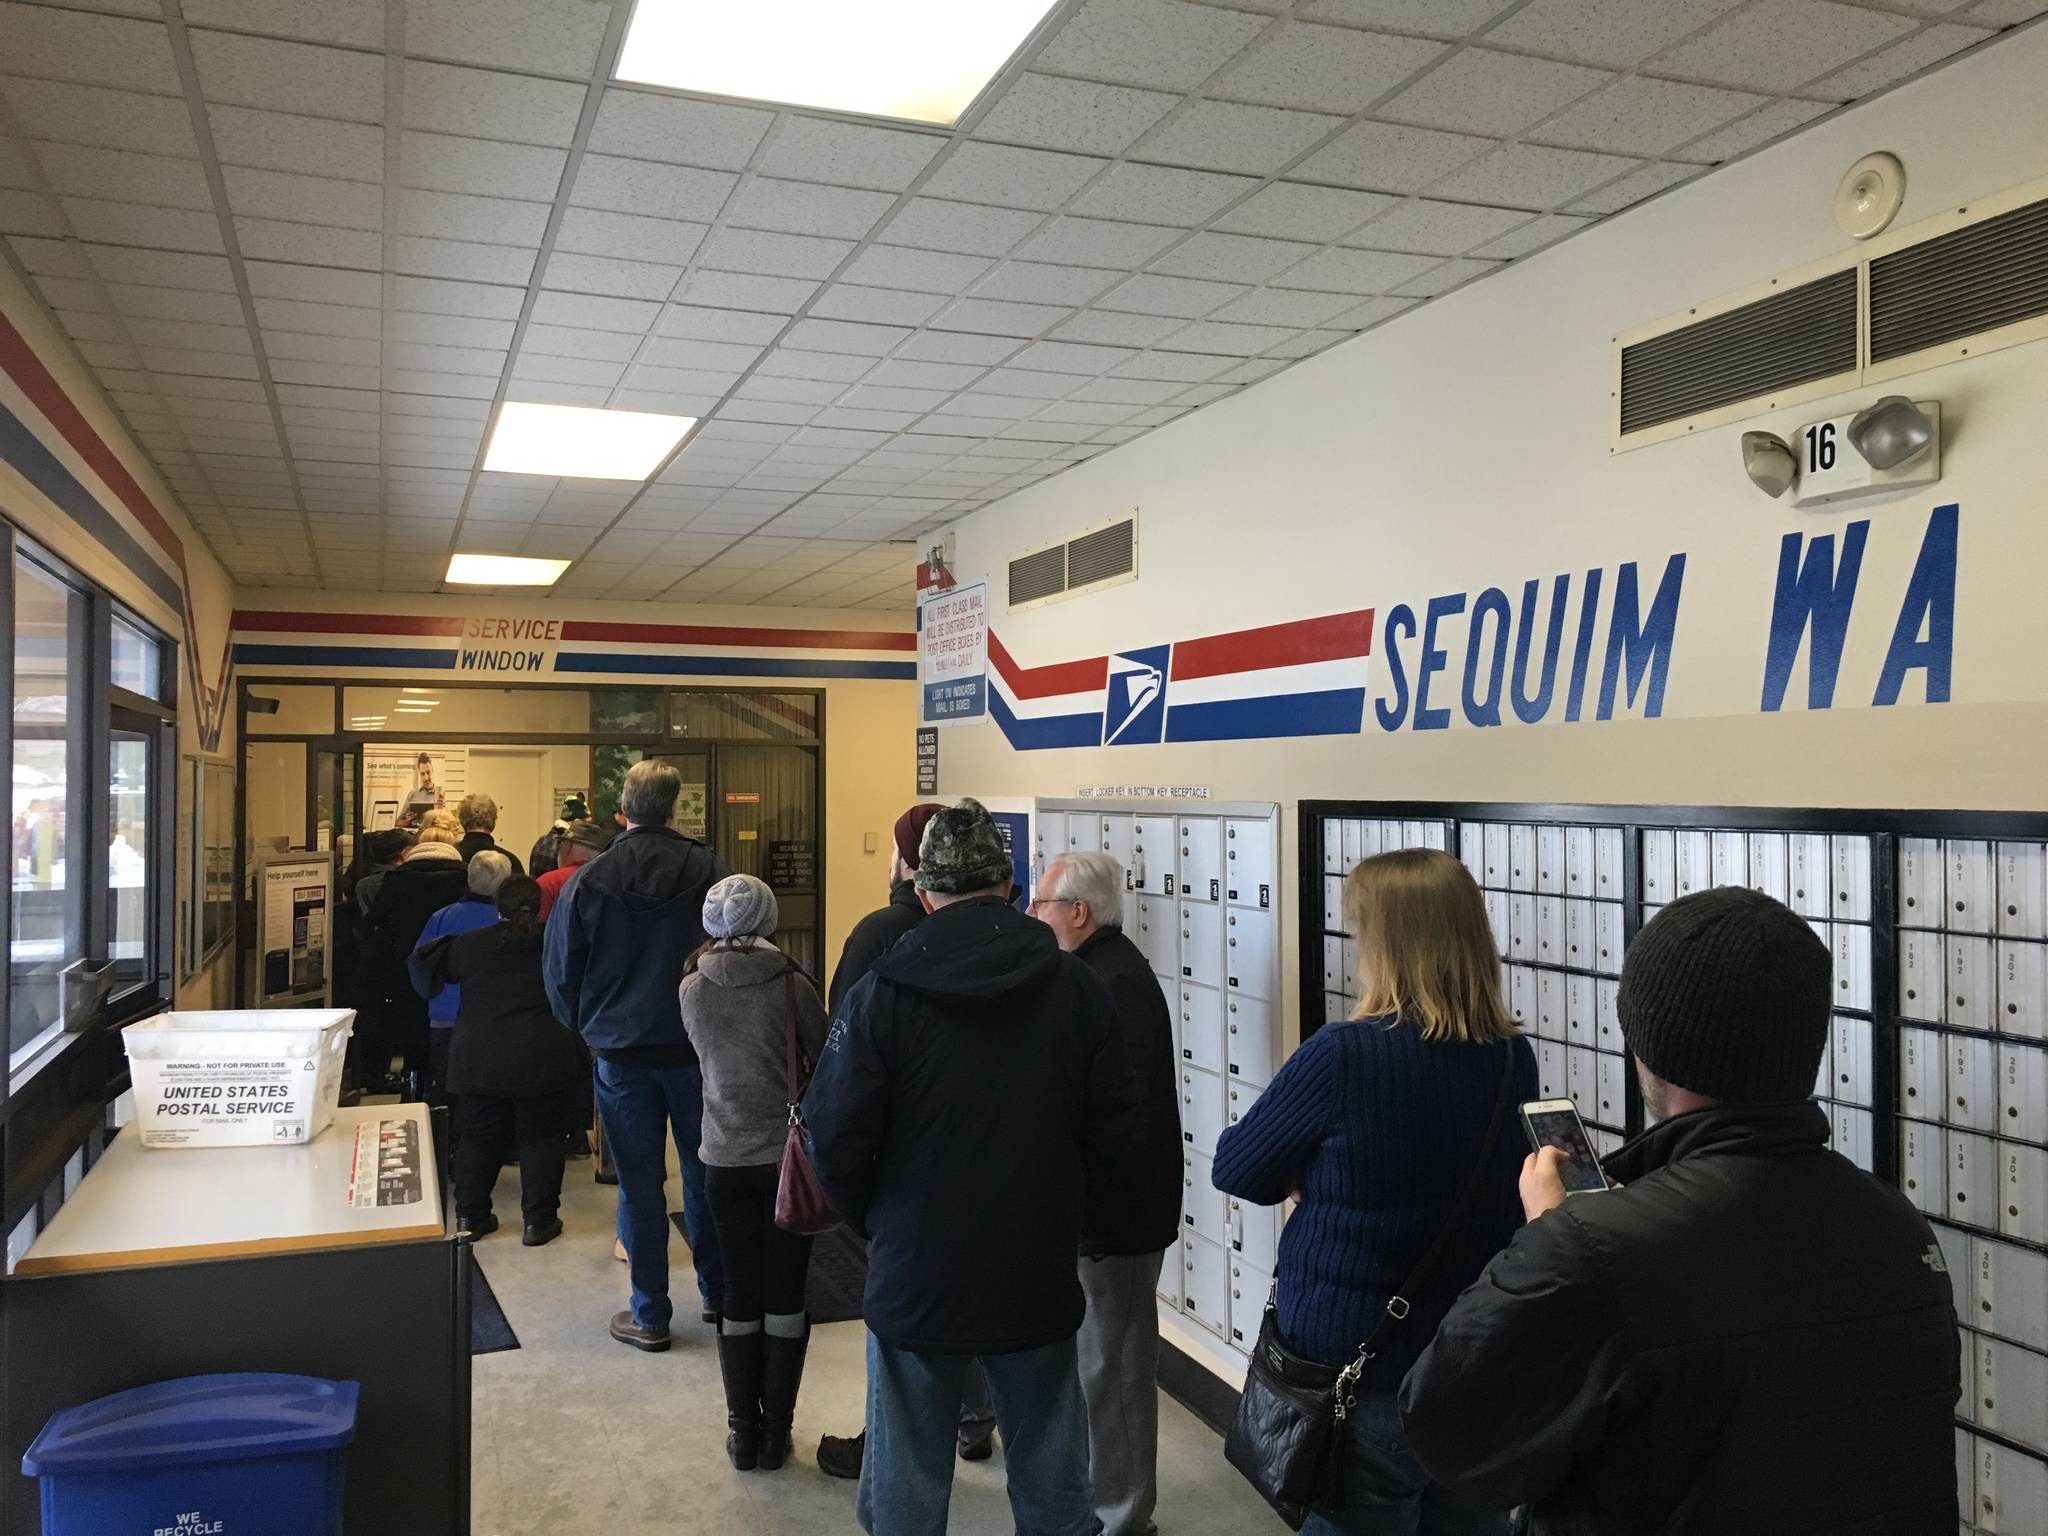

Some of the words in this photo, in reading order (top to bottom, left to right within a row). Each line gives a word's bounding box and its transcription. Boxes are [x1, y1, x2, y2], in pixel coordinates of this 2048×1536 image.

[1806, 422, 1836, 473] 16
[937, 603, 951, 619] FIRST
[951, 598, 968, 615] CLASS
[969, 594, 983, 610] MAIL
[1375, 552, 1687, 732] SEQUIM
[1760, 503, 1959, 712] WA
[468, 618, 560, 640] SERVICE
[937, 623, 944, 637] BE
[927, 641, 939, 656] POST
[939, 637, 957, 654] OFFICE
[957, 633, 974, 650] BOXES
[461, 650, 544, 671] WINDOW
[1096, 787, 1114, 797] LOCKER
[1115, 786, 1125, 796] KEY
[1133, 786, 1155, 797] BOTTOM
[1157, 786, 1167, 797] KEY
[1170, 787, 1207, 798] RECEPTACLE
[267, 872, 281, 881] Help
[282, 870, 304, 881] yourself
[305, 868, 319, 877] here
[240, 1061, 269, 1069] PRIVATE
[164, 1087, 222, 1099] UNITED
[227, 1085, 289, 1098] STATES
[156, 1103, 220, 1116] POSTAL
[226, 1101, 295, 1114] SERVICE
[1982, 1252, 1990, 1280] 205
[176, 1511, 200, 1525] WE
